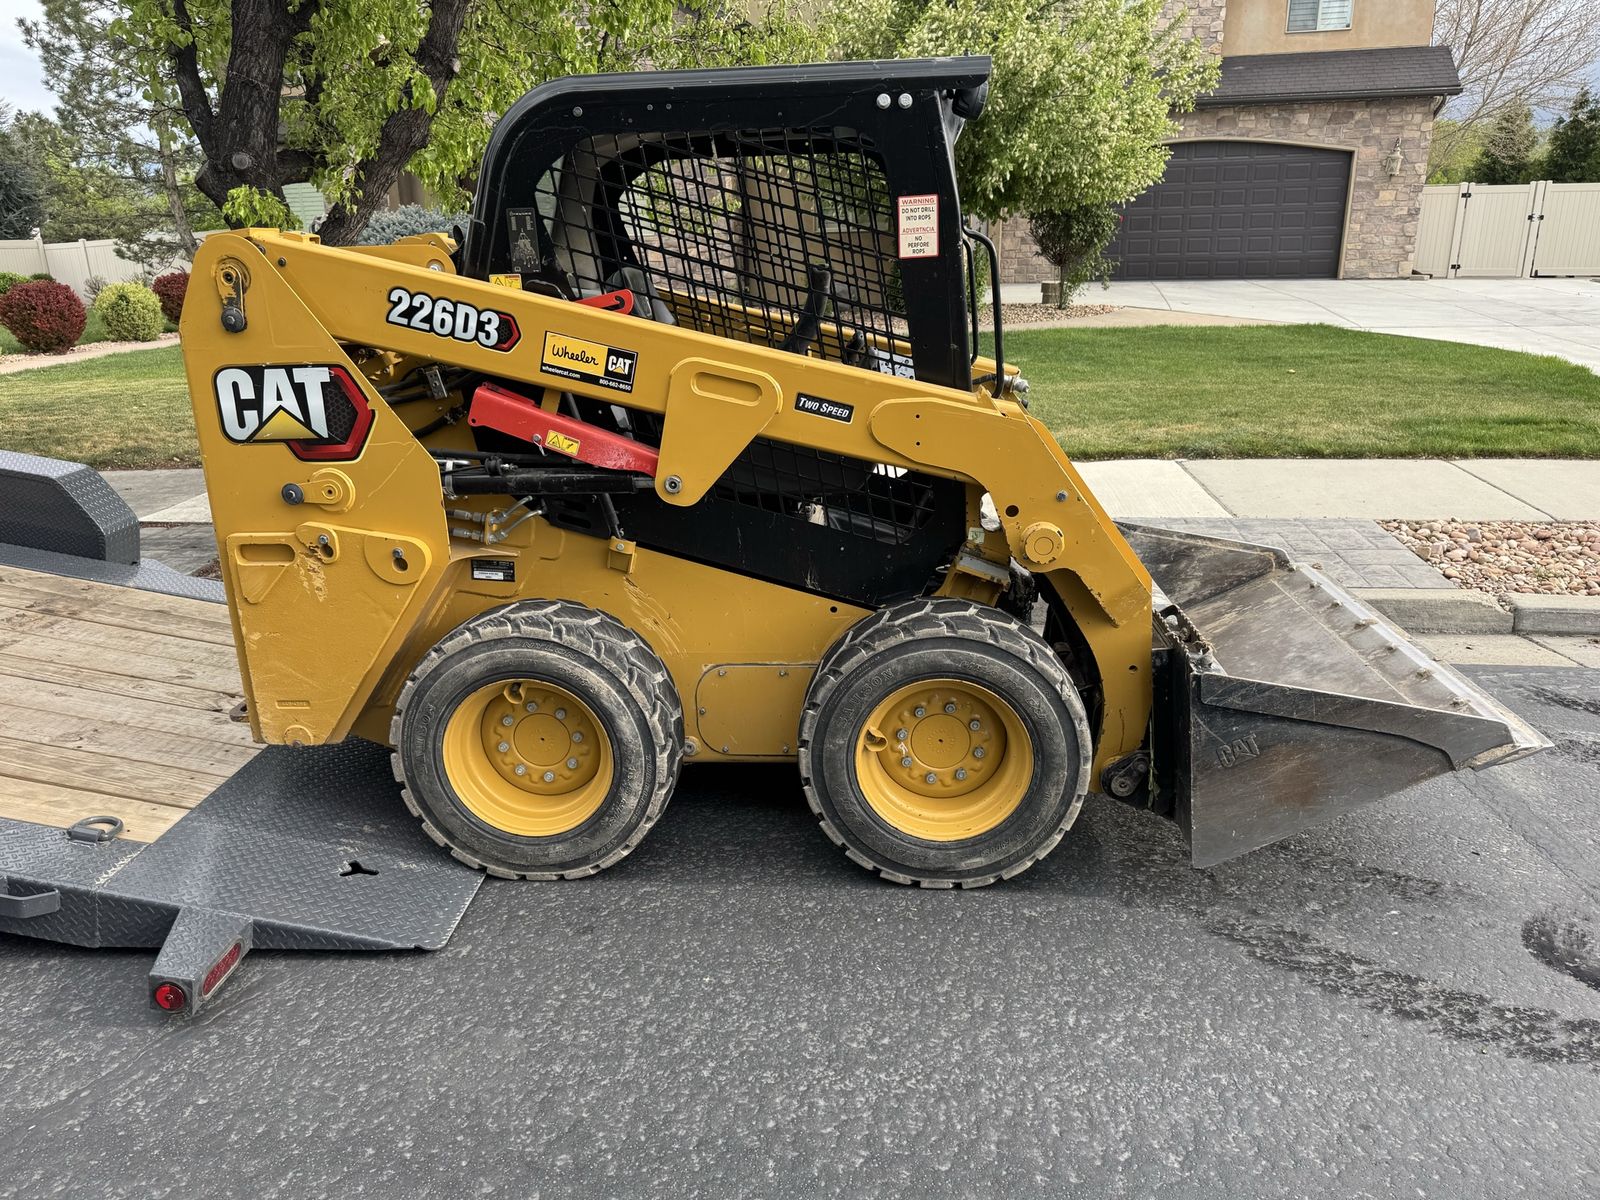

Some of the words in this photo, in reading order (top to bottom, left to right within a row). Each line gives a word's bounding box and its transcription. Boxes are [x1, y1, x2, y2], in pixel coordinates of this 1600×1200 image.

[388, 288, 500, 347] 226D3
[542, 365, 580, 378] wheelercat.com
[552, 343, 599, 366] Wheeler
[607, 355, 632, 375] CAT
[216, 367, 331, 441] CAT
[521, 641, 578, 660] NYLON
[1215, 733, 1260, 768] CAT
